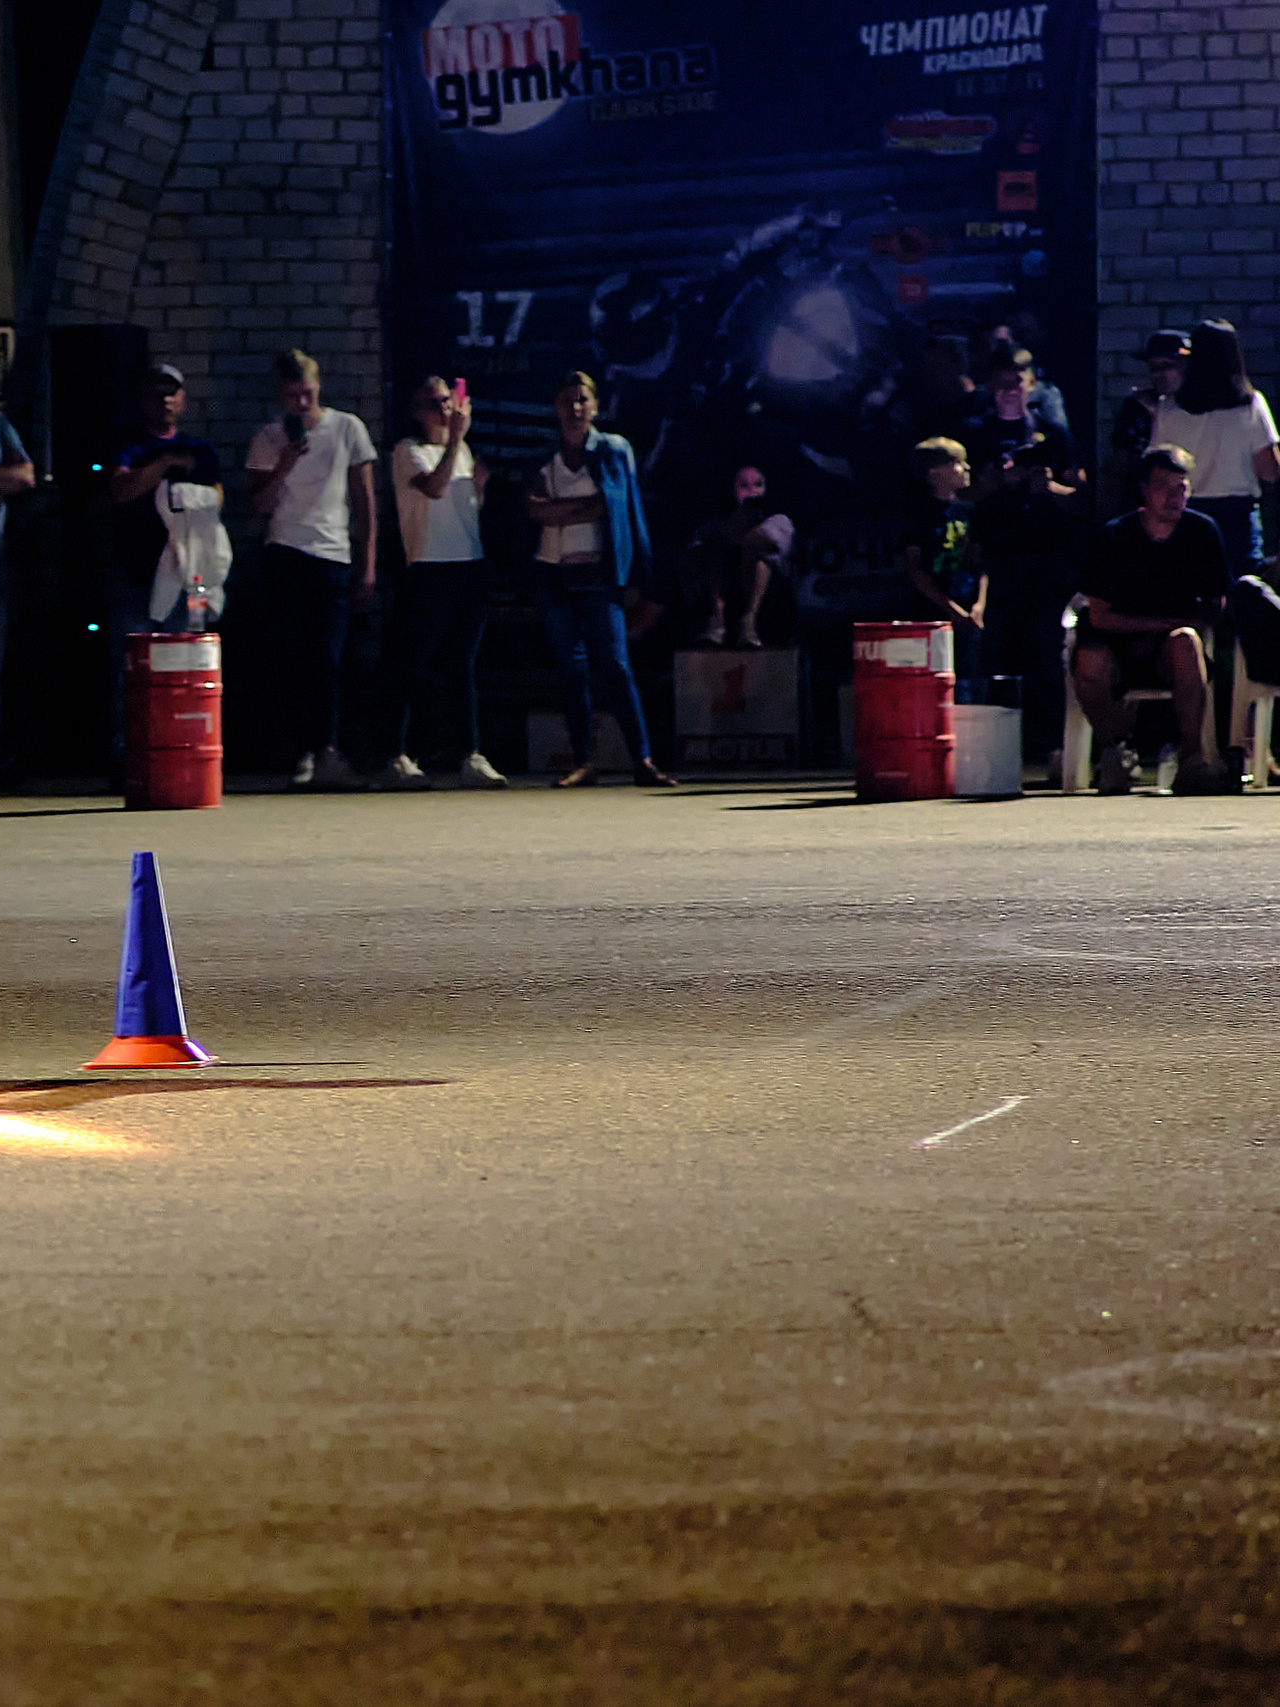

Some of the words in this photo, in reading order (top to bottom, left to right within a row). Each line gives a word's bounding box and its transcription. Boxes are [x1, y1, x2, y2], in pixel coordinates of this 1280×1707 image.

[428, 16, 567, 77] MOTO
[860, 4, 1048, 56] ЧЕМПИОНАТ
[435, 46, 718, 129] gymkhana
[455, 289, 534, 347] 17
[711, 663, 747, 715] 1
